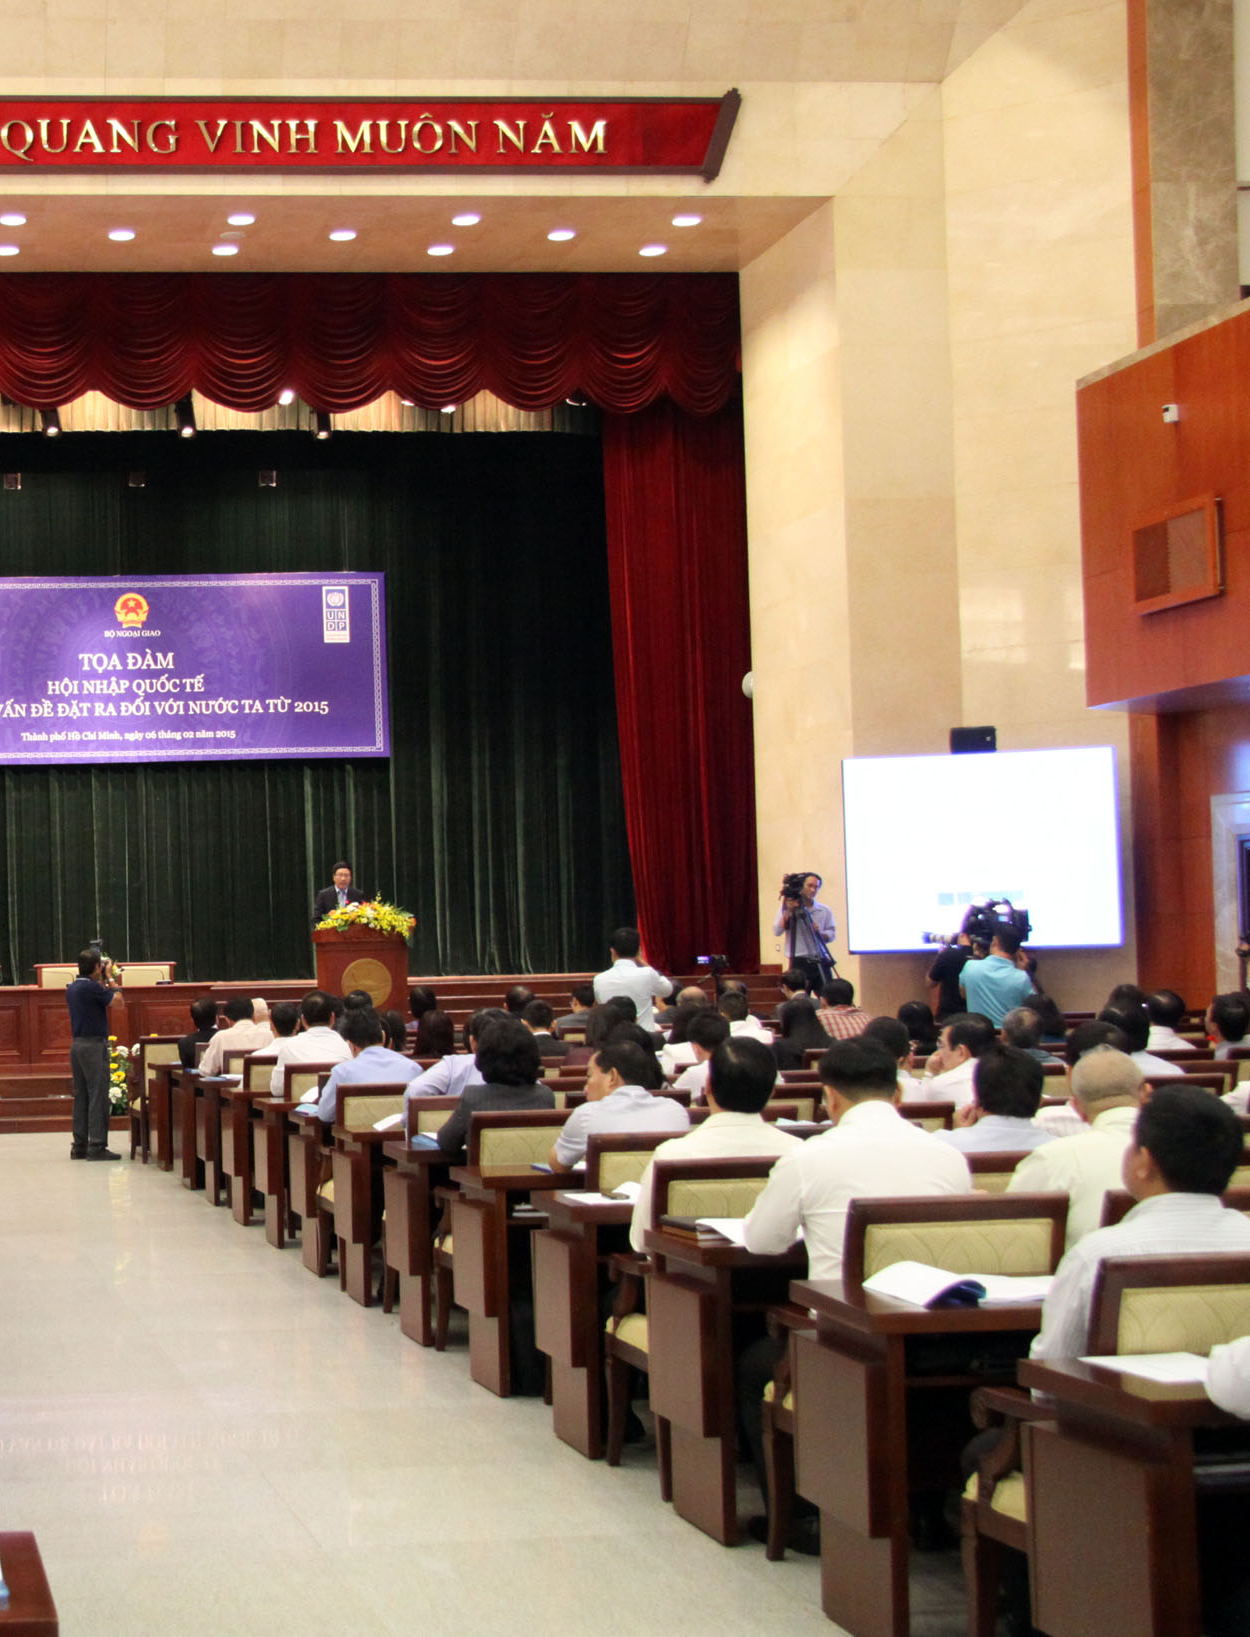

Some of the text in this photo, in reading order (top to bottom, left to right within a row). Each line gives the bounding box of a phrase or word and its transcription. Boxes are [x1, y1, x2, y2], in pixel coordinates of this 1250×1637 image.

[0, 119, 179, 162] QUANG
[195, 119, 318, 154] VINH
[333, 112, 479, 154] MUÔN
[493, 111, 608, 154] NĂM
[104, 629, 161, 638] BỘ NGOẠI GIAO
[79, 649, 174, 673] TỌA ĐÀM
[47, 673, 205, 696] HỘI NHẬP QUỐC TẾ
[30, 699, 53, 717] ĐỀ
[57, 700, 90, 719] ĐẶT
[94, 703, 116, 716] RA
[121, 697, 150, 716] ĐỐI
[154, 697, 184, 715] VỚI
[188, 697, 238, 714] NƯỚC
[241, 701, 263, 713] TA
[266, 696, 291, 713] TỪ
[294, 701, 329, 715] 2015
[21, 731, 48, 741] Thành
[50, 730, 66, 742] phố
[68, 730, 80, 740] Hồ
[82, 730, 96, 740] Chí
[98, 730, 123, 741] Minh,
[124, 732, 143, 741] ngày
[145, 731, 157, 739] 06
[158, 730, 182, 740] tháng
[196, 730, 214, 738] năm
[216, 731, 236, 739] 2015
